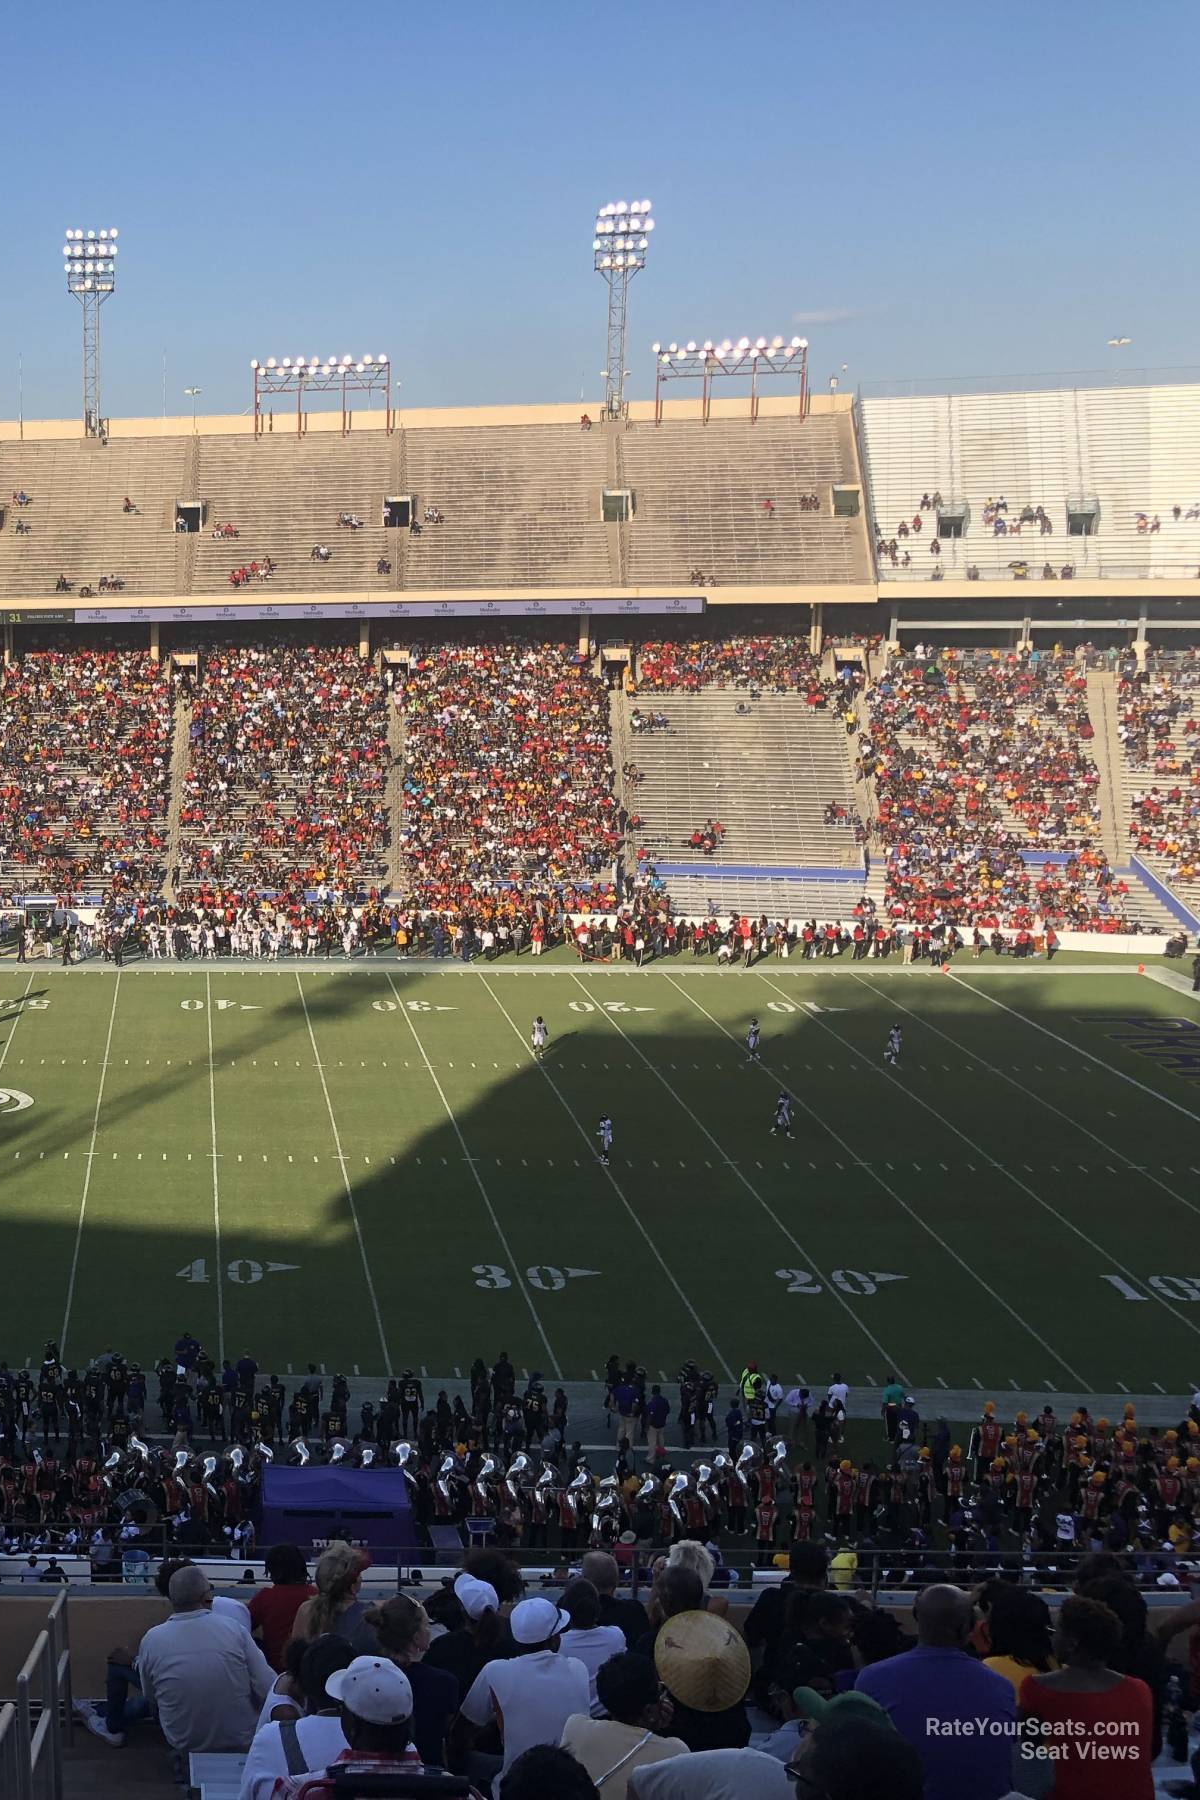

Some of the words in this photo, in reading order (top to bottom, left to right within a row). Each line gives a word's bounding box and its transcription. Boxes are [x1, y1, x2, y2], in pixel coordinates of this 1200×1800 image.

[9, 613, 22, 622] 31
[176, 1258, 264, 1284] 40
[471, 1264, 566, 1290] 30
[775, 1268, 878, 1295] 20
[1099, 1275, 1200, 1301] 10
